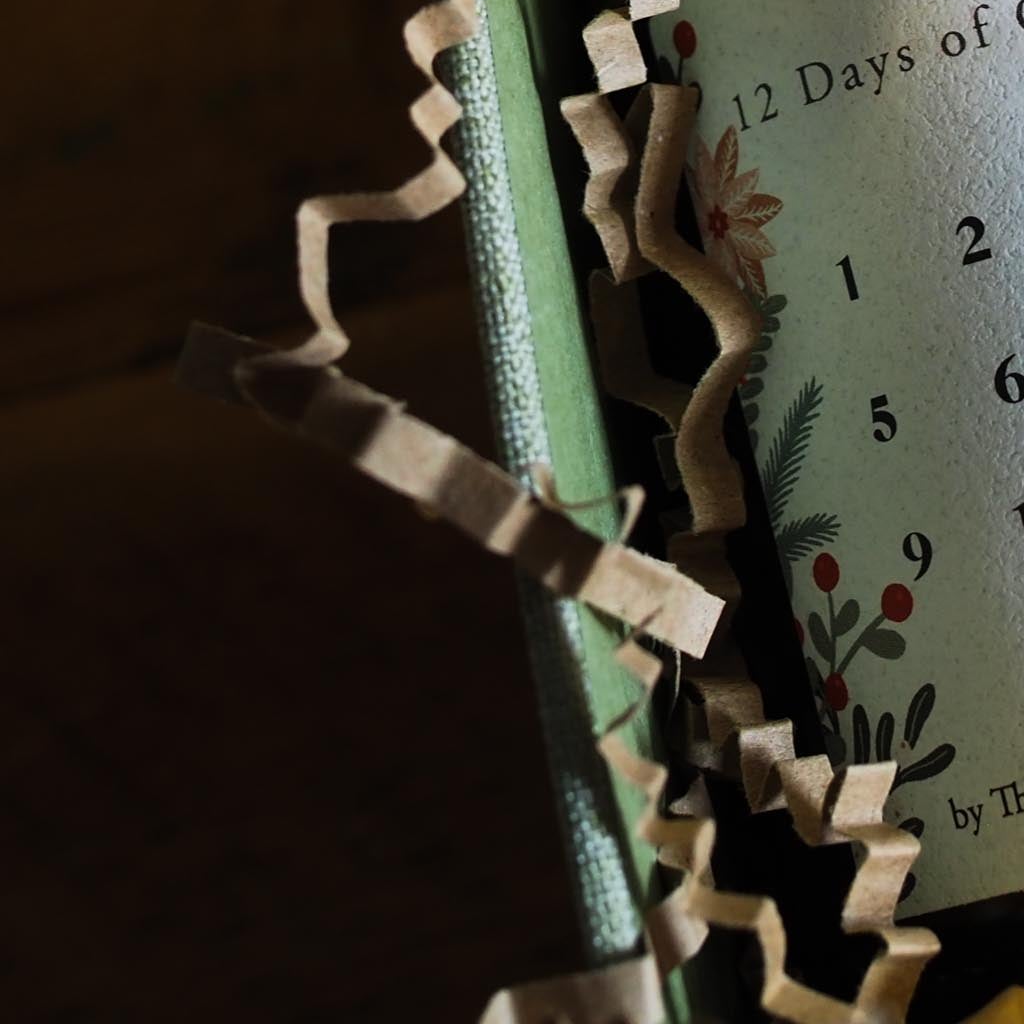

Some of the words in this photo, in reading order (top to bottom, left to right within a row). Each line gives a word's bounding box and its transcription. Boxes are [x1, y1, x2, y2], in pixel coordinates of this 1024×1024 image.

[731, 82, 779, 132] 12
[794, 44, 916, 107] Days
[939, 3, 992, 58] of
[835, 254, 860, 301] 1
[955, 215, 993, 266] 2
[870, 394, 897, 443] 5
[902, 531, 933, 582] 9
[947, 797, 985, 837] by
